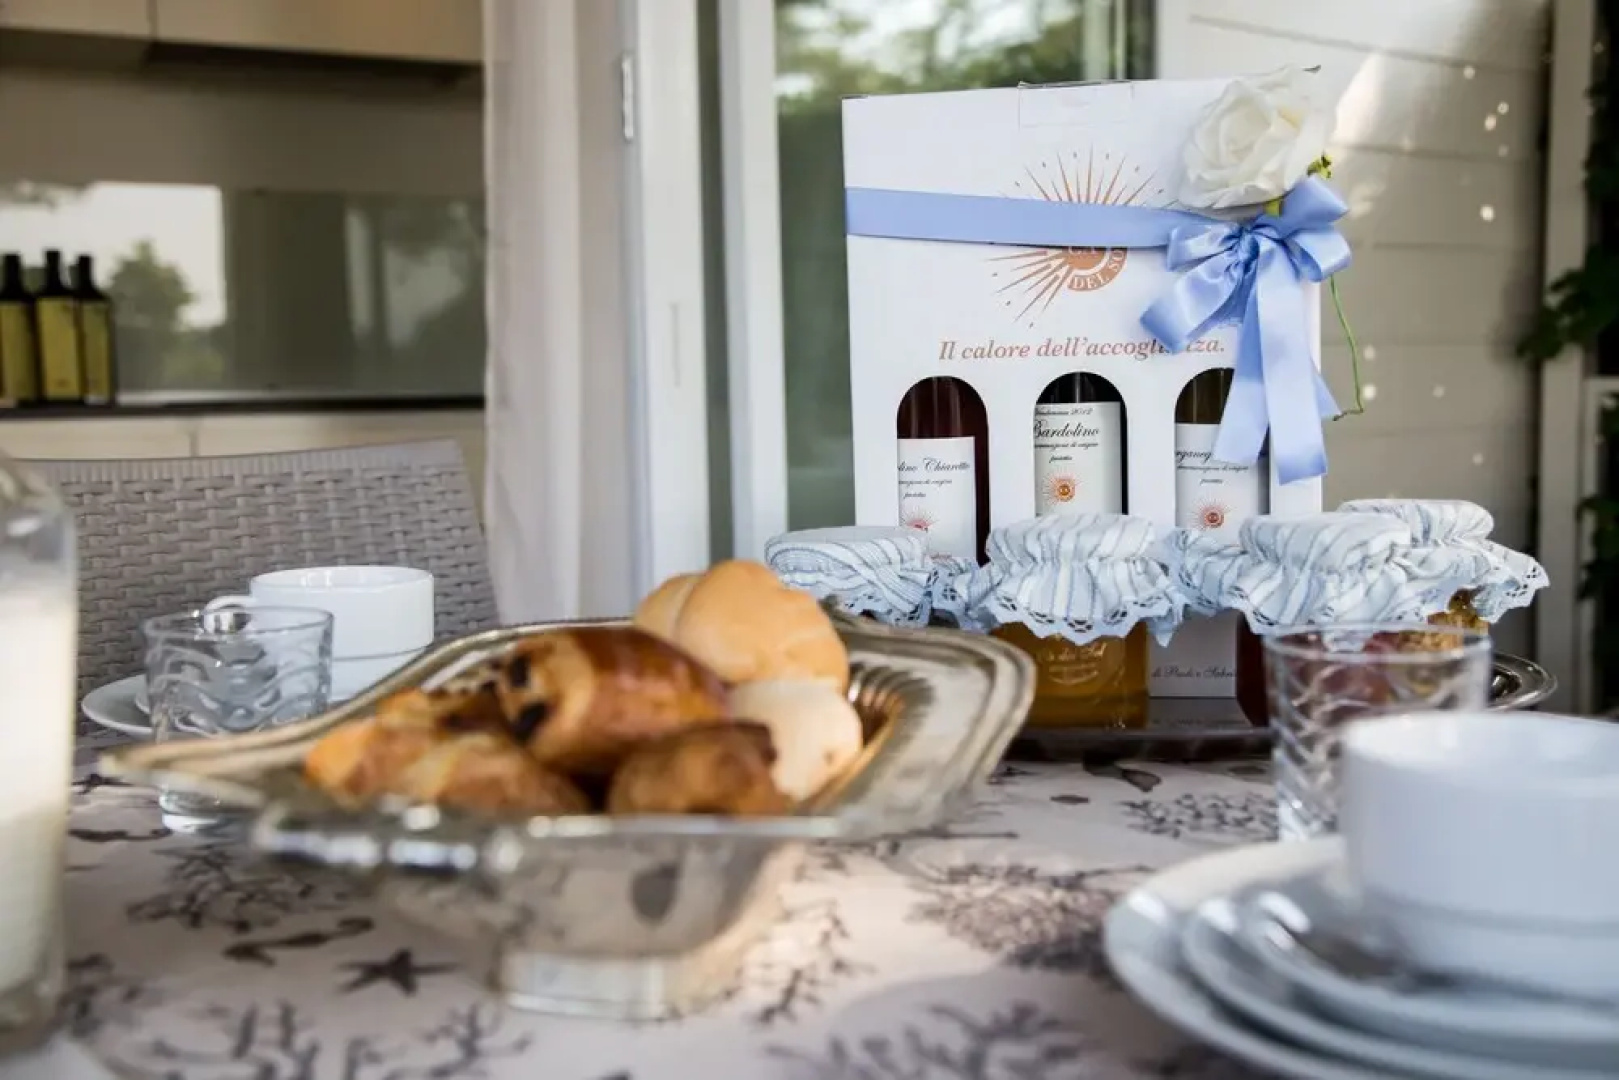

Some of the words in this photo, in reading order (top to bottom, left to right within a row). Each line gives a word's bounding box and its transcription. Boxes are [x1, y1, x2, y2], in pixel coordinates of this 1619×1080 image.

[938, 341, 956, 360] Il
[961, 339, 1031, 359] calore
[1034, 420, 1099, 438] Bardolino
